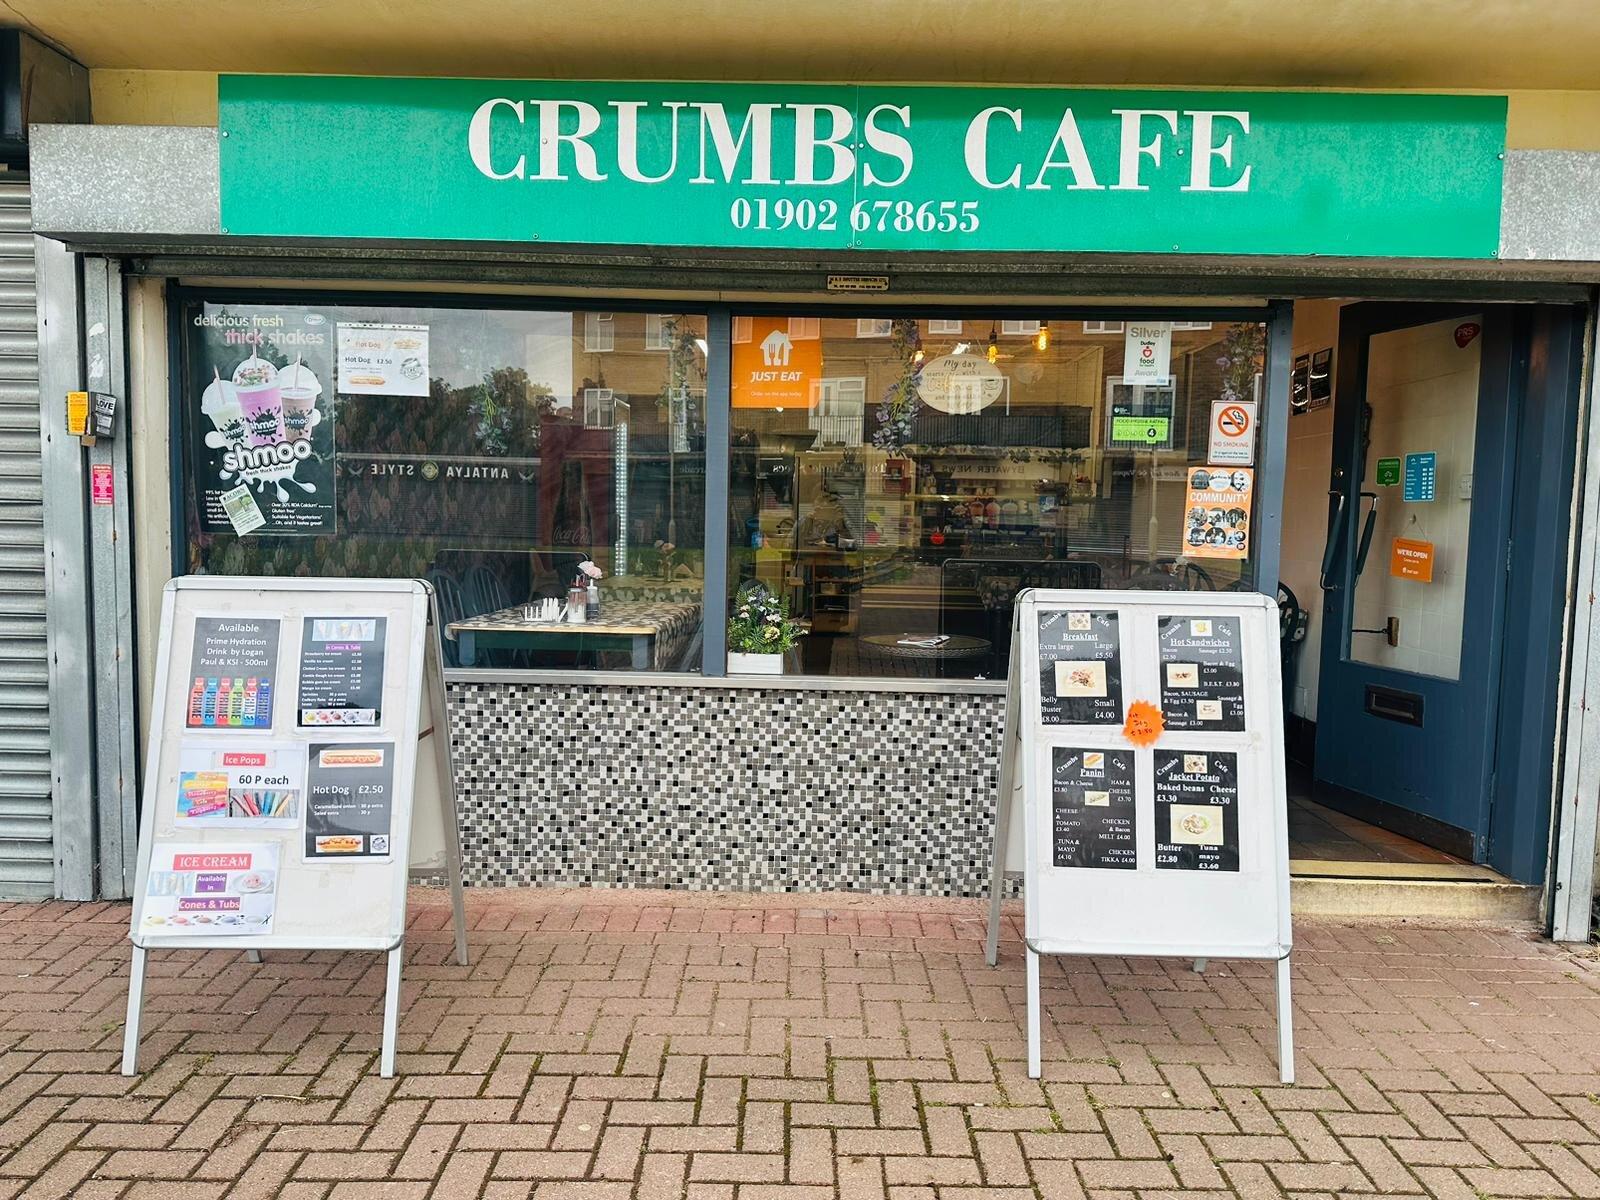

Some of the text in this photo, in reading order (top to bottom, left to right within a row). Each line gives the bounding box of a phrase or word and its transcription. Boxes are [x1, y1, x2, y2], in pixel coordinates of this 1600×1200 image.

[467, 97, 1252, 192] CRUMBS CAFE
[730, 197, 980, 232] 01902 678655
[194, 314, 283, 327] delicious fresh
[225, 328, 325, 345] thick shakes
[1130, 327, 1166, 338] Silver
[1457, 326, 1473, 337] PRS
[962, 360, 977, 370] day
[1140, 357, 1155, 365] food
[751, 371, 802, 383] JUST EAT
[1134, 369, 1158, 377] Award
[223, 438, 312, 473] shmoo
[273, 465, 291, 473] shakes
[1190, 492, 1248, 503] COMMUNITY
[1413, 551, 1428, 560] OPEN
[1040, 612, 1062, 630] Crumbs
[218, 623, 259, 633] Available
[1160, 623, 1182, 640] Crumbs
[1062, 632, 1099, 641] Breakfast
[206, 637, 267, 647] Prime Hydration
[1058, 643, 1074, 651] large
[1094, 642, 1114, 650] Large
[1170, 638, 1230, 647] Hot Sandwiches
[230, 648, 240, 657] by
[241, 648, 264, 657] Logan
[244, 658, 268, 666] 500ml
[1041, 696, 1058, 704] Belly
[1094, 699, 1115, 707] Small
[225, 756, 261, 766] Ice Pops
[1056, 755, 1079, 774] Crumbs
[1156, 757, 1179, 776] Crumbs
[1080, 768, 1105, 778] Panini
[1168, 772, 1220, 782] Jacket Potato
[239, 774, 289, 785] 60 P each
[313, 785, 384, 795] Hot Dog £2.50
[1156, 783, 1237, 793] Baked beans Cheese
[1209, 797, 1230, 805] £3.30
[1157, 843, 1182, 851] Butter
[180, 856, 248, 868] ICE CREAM
[1157, 855, 1178, 863] £2.80
[179, 900, 240, 909] Cones & Tubs
